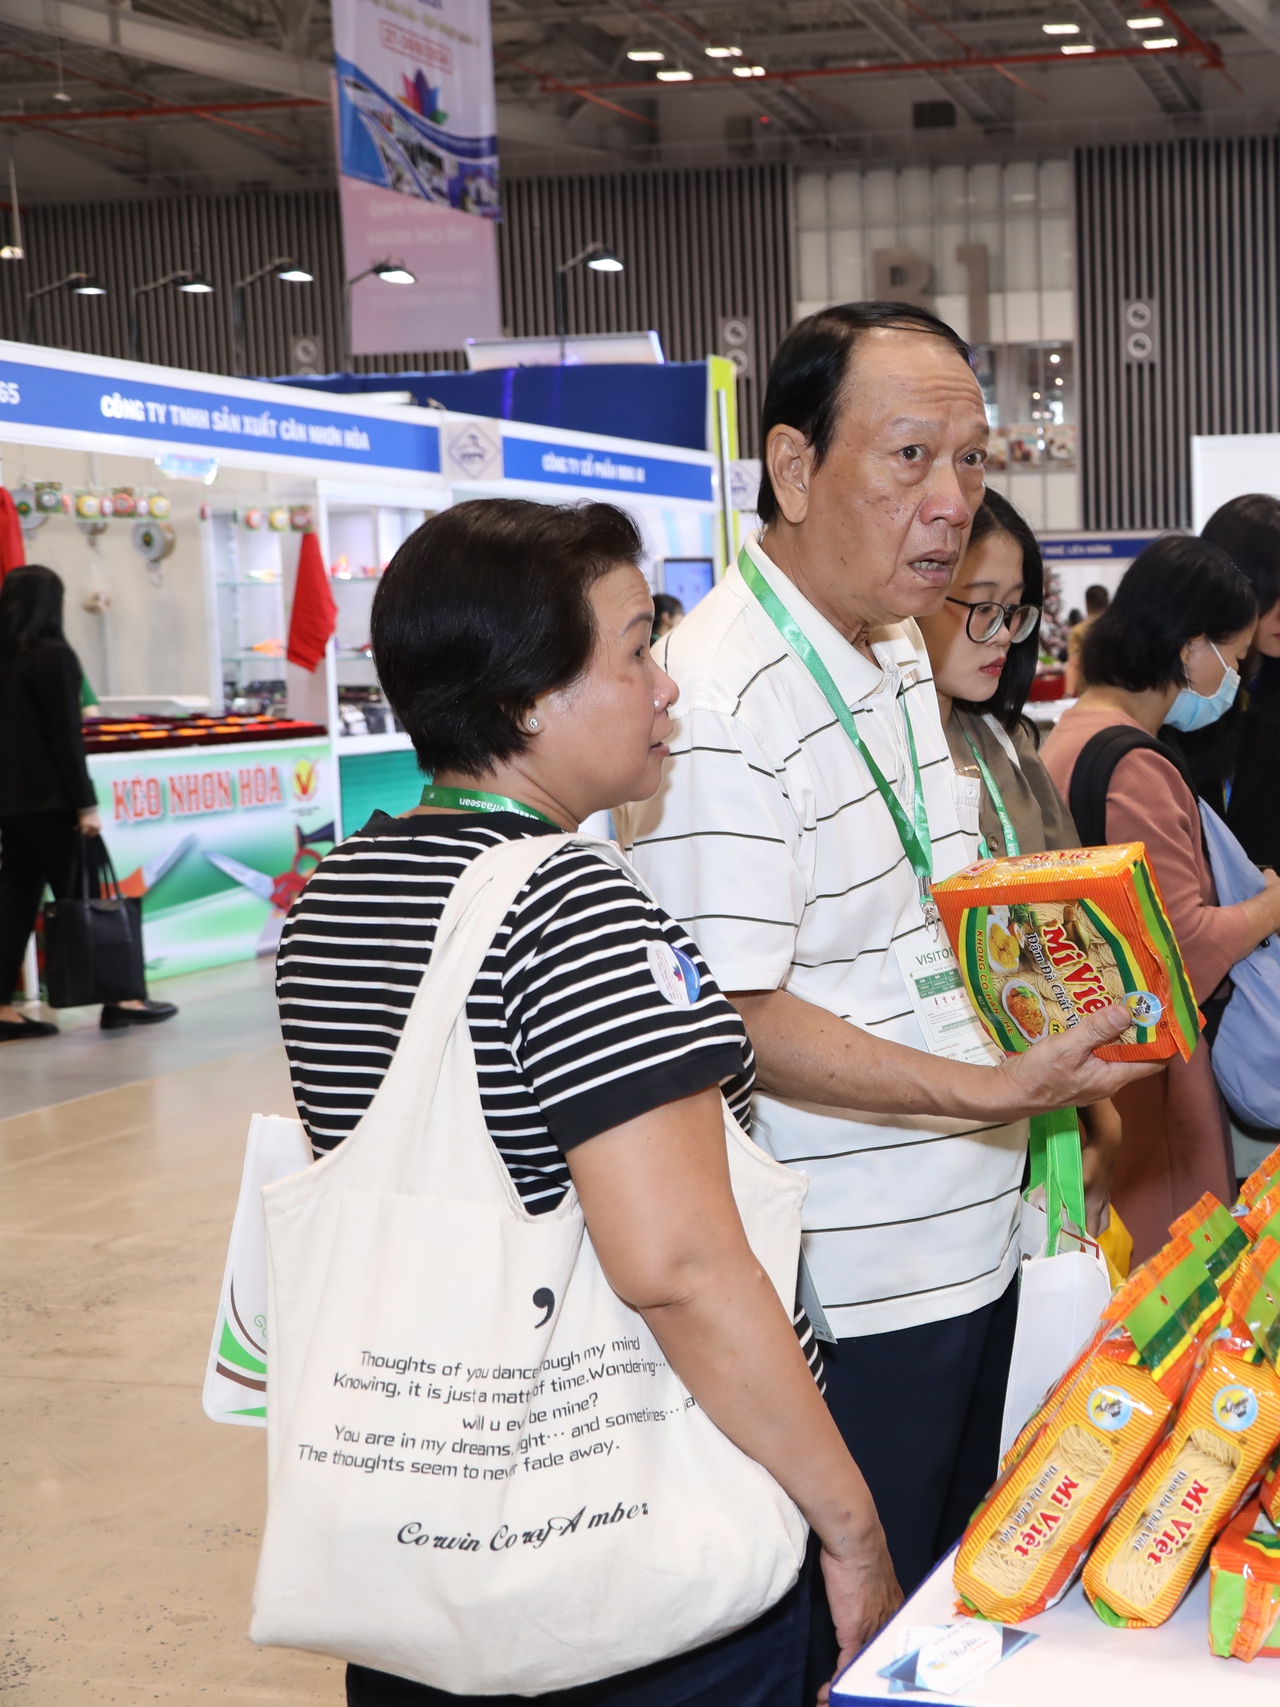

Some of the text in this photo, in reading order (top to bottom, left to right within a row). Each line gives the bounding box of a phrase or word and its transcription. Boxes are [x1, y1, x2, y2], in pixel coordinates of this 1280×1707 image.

[100, 392, 146, 422] CÔNG
[146, 402, 168, 424] TY
[168, 404, 211, 430] TNHH
[112, 762, 283, 822] KÉO NHƠN HÒA
[1062, 961, 1114, 1015] Việ
[361, 1351, 436, 1375] Thoughts
[442, 1362, 462, 1377] of
[466, 1367, 490, 1382] you
[584, 1343, 606, 1359] my
[612, 1336, 640, 1352] mind
[333, 1372, 402, 1398] Knowing,
[408, 1381, 422, 1397] it
[427, 1383, 442, 1399] is
[443, 1386, 476, 1404] just
[478, 1392, 487, 1403] a
[492, 1389, 532, 1404] matt
[532, 1380, 545, 1397] of
[462, 1415, 485, 1431] will
[490, 1420, 500, 1431] u
[529, 1409, 547, 1424] be
[553, 1392, 599, 1420] mine?
[334, 1424, 361, 1442] You
[365, 1433, 395, 1447] are
[400, 1433, 416, 1449] in
[421, 1437, 447, 1456] my
[451, 1438, 514, 1457] dreams,
[571, 1416, 600, 1439] and
[299, 1444, 328, 1463] The
[333, 1450, 404, 1473] thoughts
[410, 1461, 458, 1477] seem
[463, 1464, 479, 1479] to
[523, 1452, 564, 1472] fade
[569, 1440, 620, 1462] away.
[397, 1522, 482, 1552] Corwin
[1014, 1474, 1080, 1559] Mì Việt
[1147, 1479, 1210, 1566] Mì Việt
